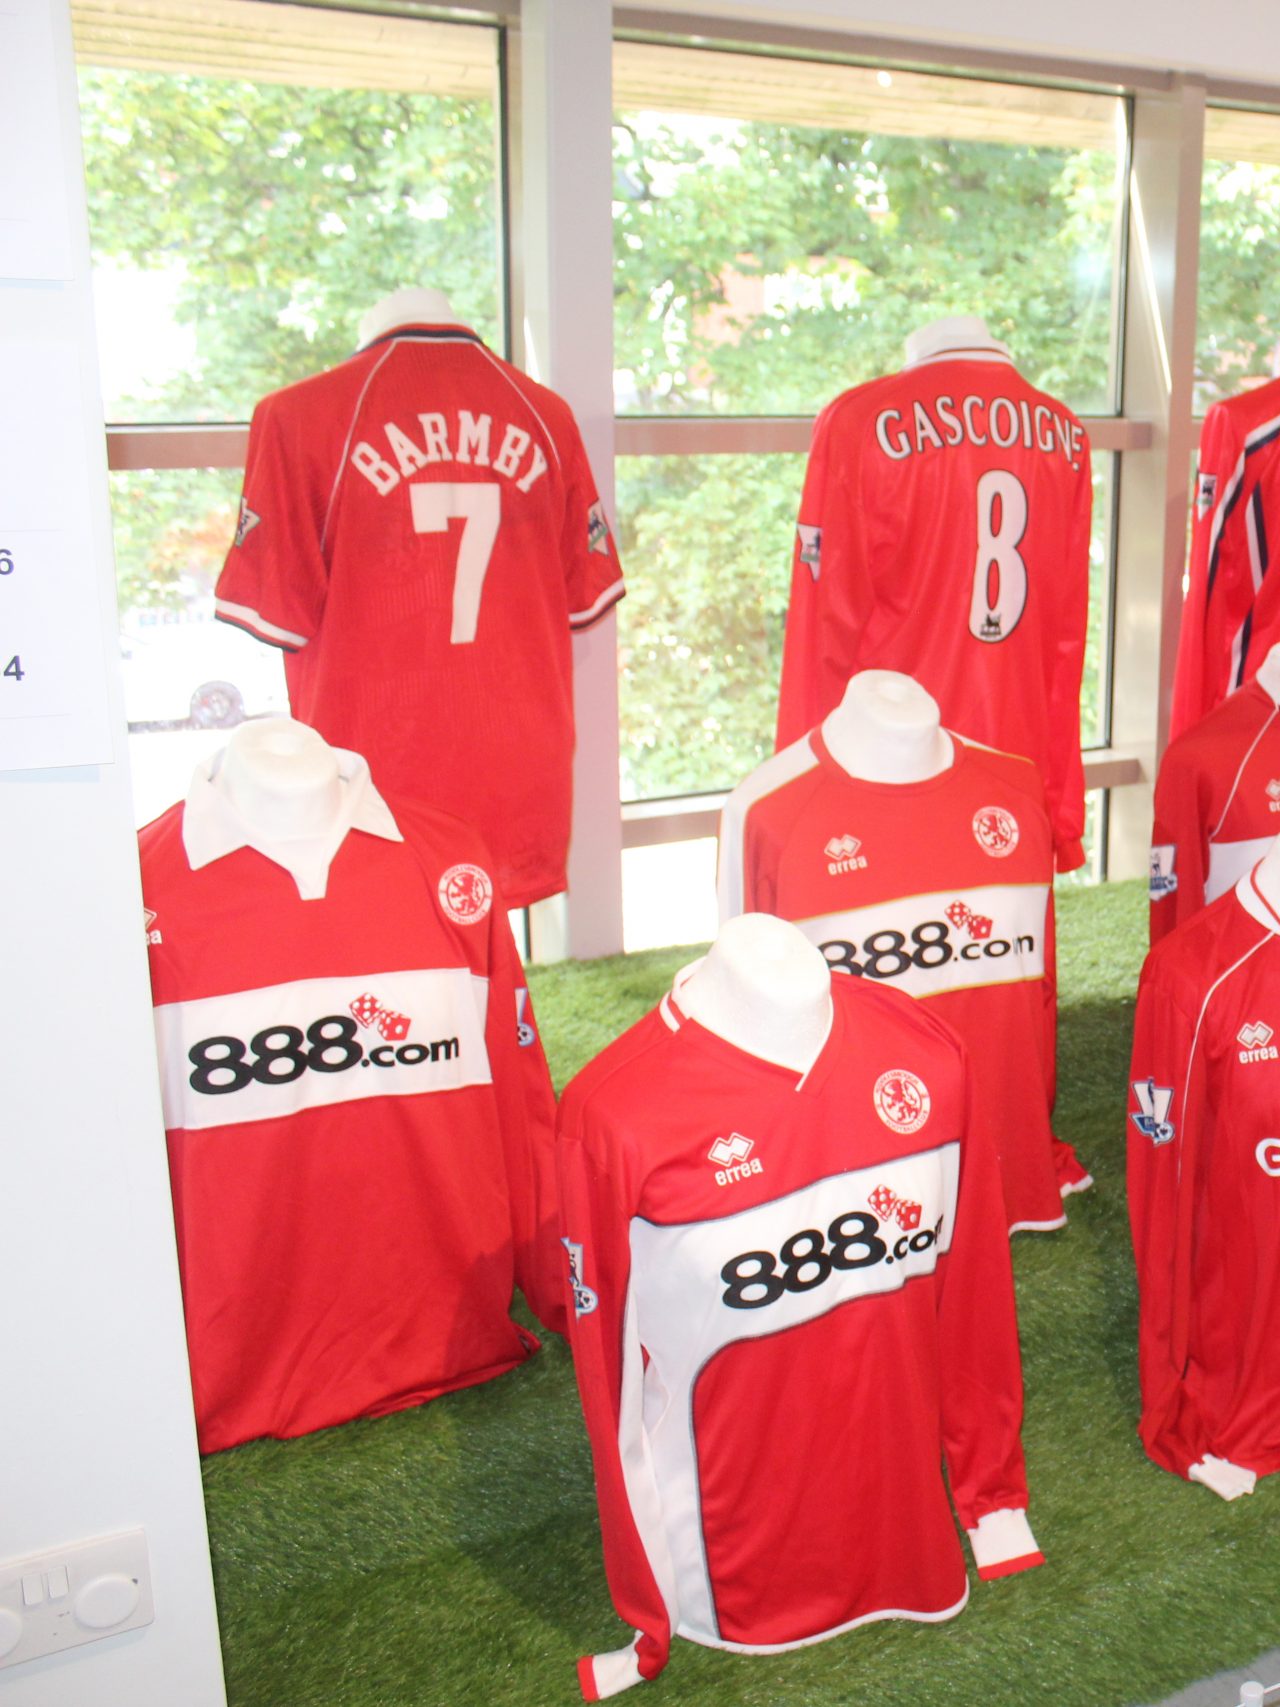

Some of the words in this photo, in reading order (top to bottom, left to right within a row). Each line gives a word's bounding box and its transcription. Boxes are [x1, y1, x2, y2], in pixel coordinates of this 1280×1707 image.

[351, 409, 548, 496] BARMBY
[409, 482, 500, 644] 7
[969, 469, 1028, 643] 8
[828, 856, 868, 876] errea
[189, 1015, 459, 1095] 888.com
[1239, 1046, 1279, 1064] errea
[715, 1157, 763, 1187] errea
